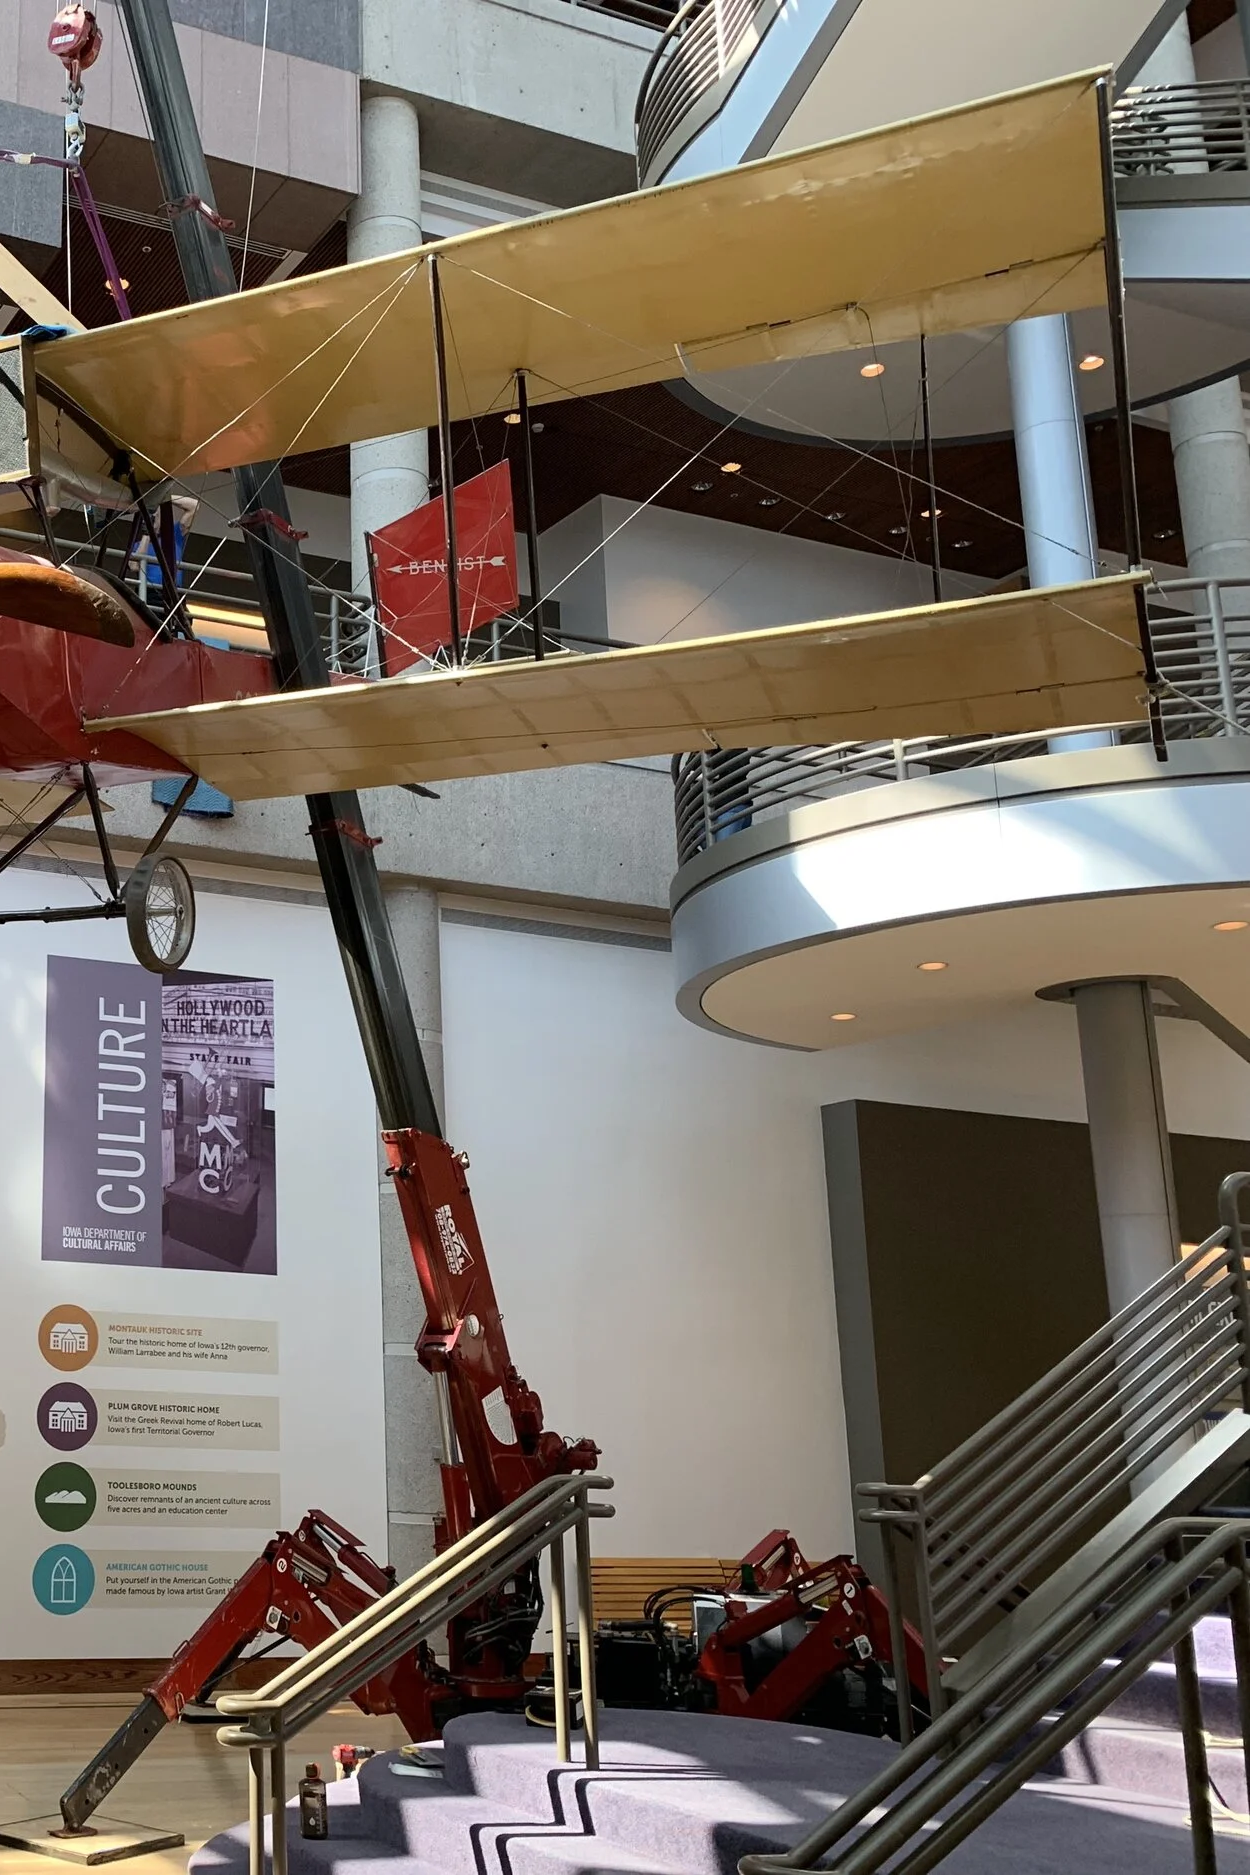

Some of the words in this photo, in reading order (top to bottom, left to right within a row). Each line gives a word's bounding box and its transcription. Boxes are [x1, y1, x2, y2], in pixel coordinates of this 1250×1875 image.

[409, 556, 485, 576] BENIST
[177, 999, 265, 1016] HOLLYWOOD
[171, 1018, 196, 1034] THE
[200, 1019, 274, 1039] HEARTLA
[227, 1056, 251, 1066] FAIR
[96, 996, 147, 1215] CULTURE
[199, 1141, 222, 1170] M
[199, 1168, 220, 1194] C
[62, 1226, 82, 1237] IOWA
[84, 1227, 136, 1241] DEPARTMENT
[136, 1231, 147, 1242] OF
[443, 1204, 465, 1268] ROYAL
[62, 1237, 103, 1250] CULTURAL
[104, 1240, 136, 1252] AFFAIRS
[108, 1324, 148, 1334] MONTAUK
[150, 1326, 185, 1335] HISTORIC
[108, 1337, 124, 1345] Tour
[139, 1339, 165, 1347] historic
[166, 1340, 187, 1348] home
[189, 1341, 196, 1349] of
[198, 1342, 219, 1350] Iowa's
[237, 1345, 270, 1353] governor,
[108, 1347, 134, 1355] William
[136, 1349, 166, 1357] Larrabee
[194, 1351, 208, 1359] wife
[210, 1352, 228, 1360] Anna
[108, 1403, 130, 1411] PLUM
[131, 1404, 158, 1412] GROVE
[160, 1405, 195, 1413] HISTORIC
[197, 1406, 220, 1414] HOME
[108, 1415, 123, 1423] Visit
[138, 1416, 158, 1424] Greek
[160, 1417, 185, 1425] Revival
[186, 1418, 206, 1426] home
[107, 1426, 130, 1434] Iowa's
[131, 1426, 145, 1434] first
[147, 1427, 181, 1435] Territorial
[182, 1428, 215, 1436] Governor
[108, 1482, 161, 1490] TOOLESBORO
[162, 1483, 197, 1491] MOUNDS
[108, 1494, 139, 1502] Discover
[140, 1496, 174, 1504] remnants
[175, 1496, 183, 1504] of
[195, 1497, 221, 1505] ancient
[223, 1497, 247, 1505] culture
[107, 1505, 120, 1513] five
[168, 1506, 203, 1514] education
[106, 1563, 148, 1571] AMERICAN
[106, 1576, 118, 1584] Put
[120, 1576, 149, 1586] yourself
[151, 1576, 158, 1584] in
[208, 1576, 232, 1585] Gothic
[106, 1587, 127, 1595] made
[128, 1587, 155, 1595] famous
[156, 1587, 165, 1597] by
[167, 1587, 184, 1595] Iowa
[186, 1587, 204, 1595] artist
[206, 1587, 226, 1595] Grant
